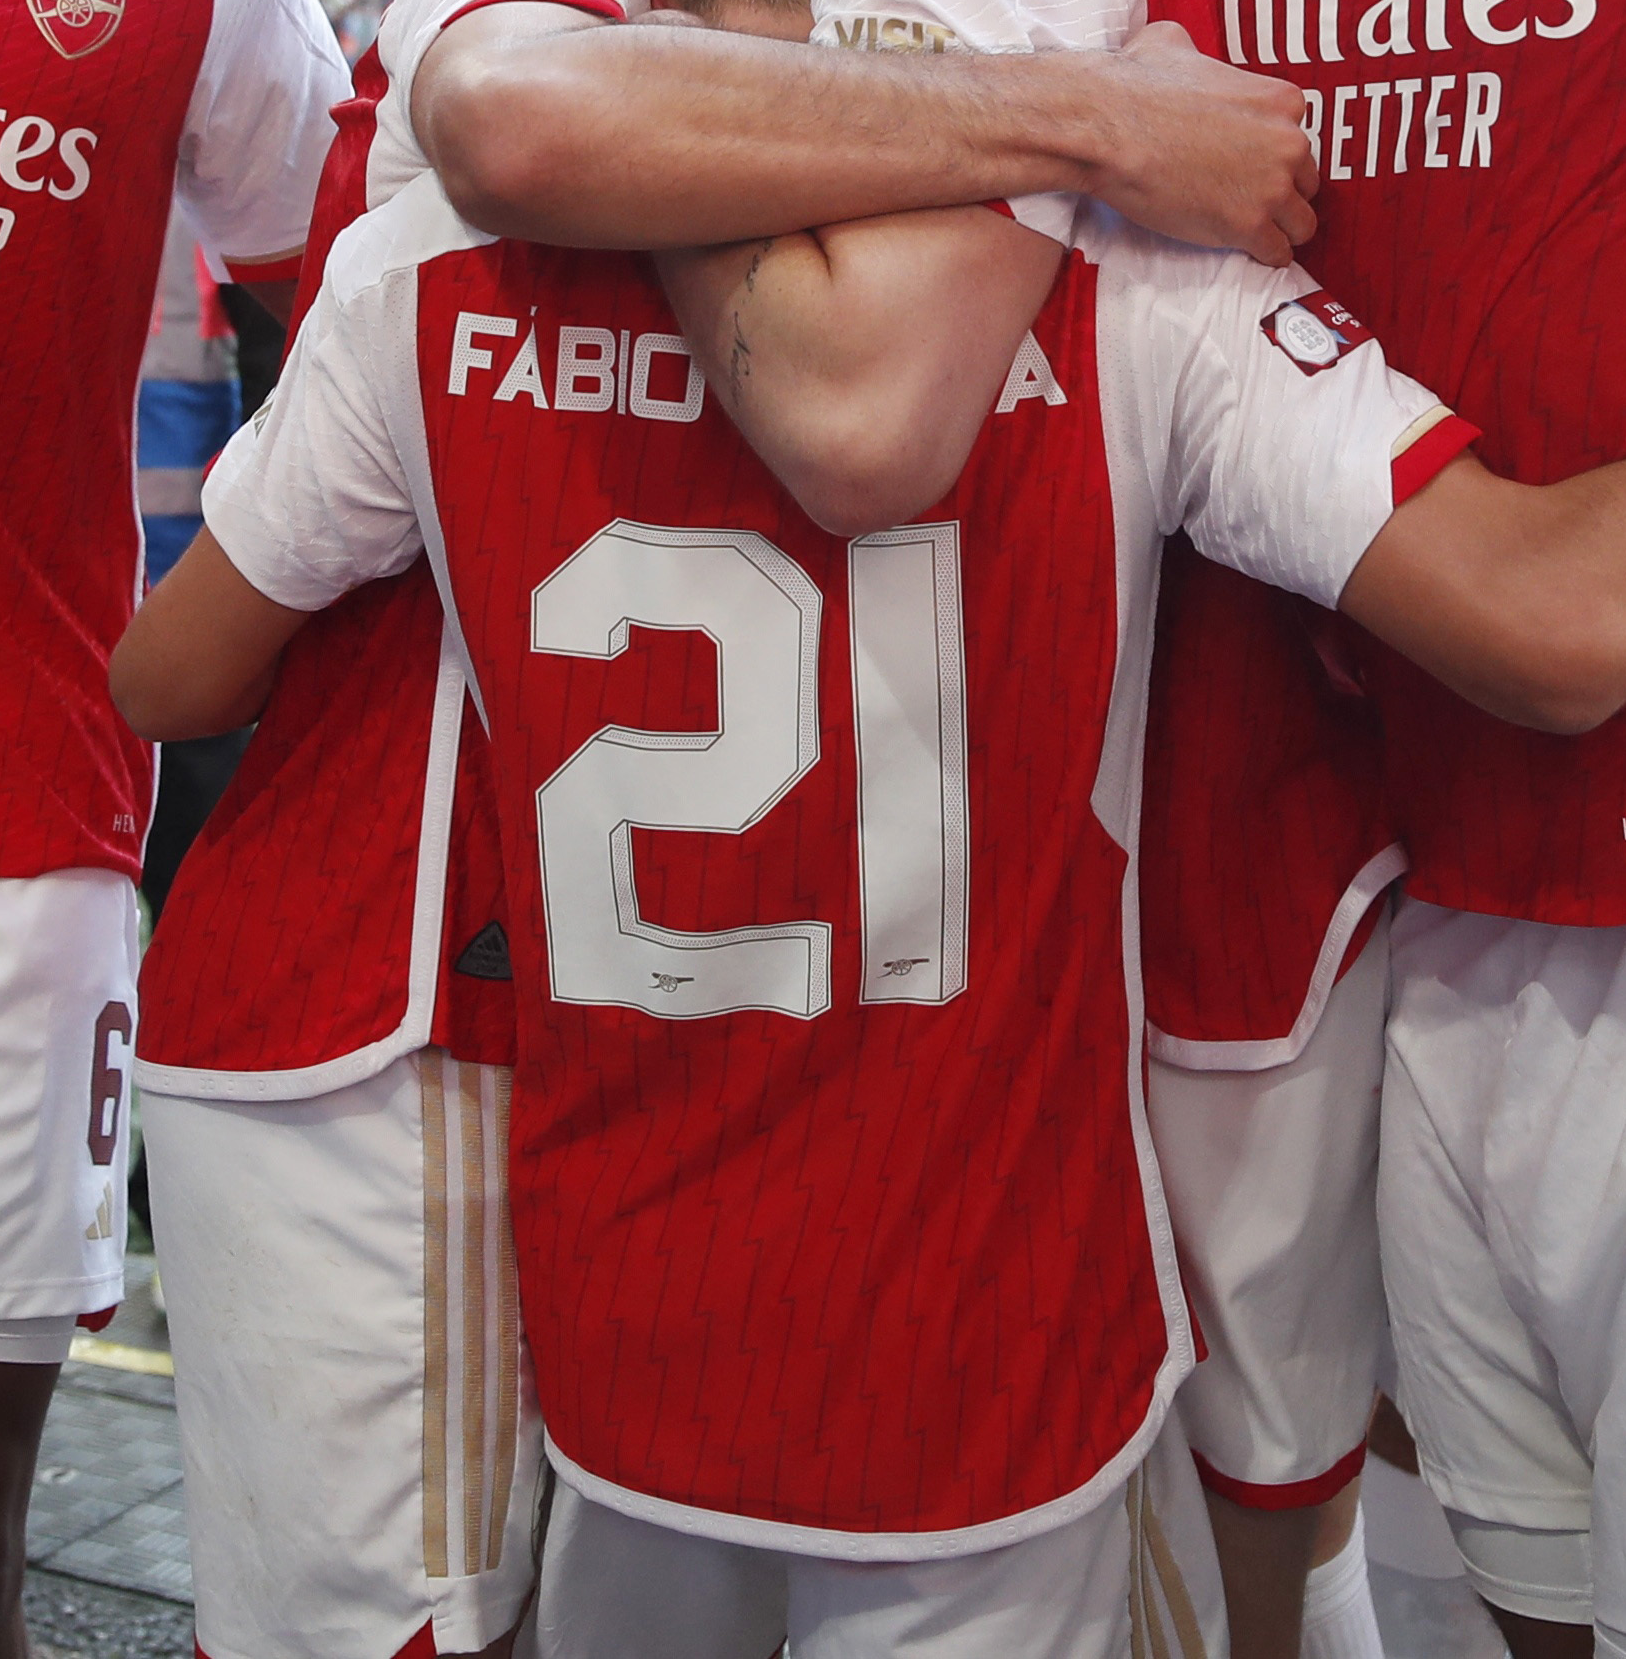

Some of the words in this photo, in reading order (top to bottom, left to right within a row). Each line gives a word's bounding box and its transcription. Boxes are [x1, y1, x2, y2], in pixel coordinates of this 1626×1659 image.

[447, 305, 706, 423] FÁBIO
[529, 517, 968, 1021] 21
[86, 999, 133, 1167] 6
